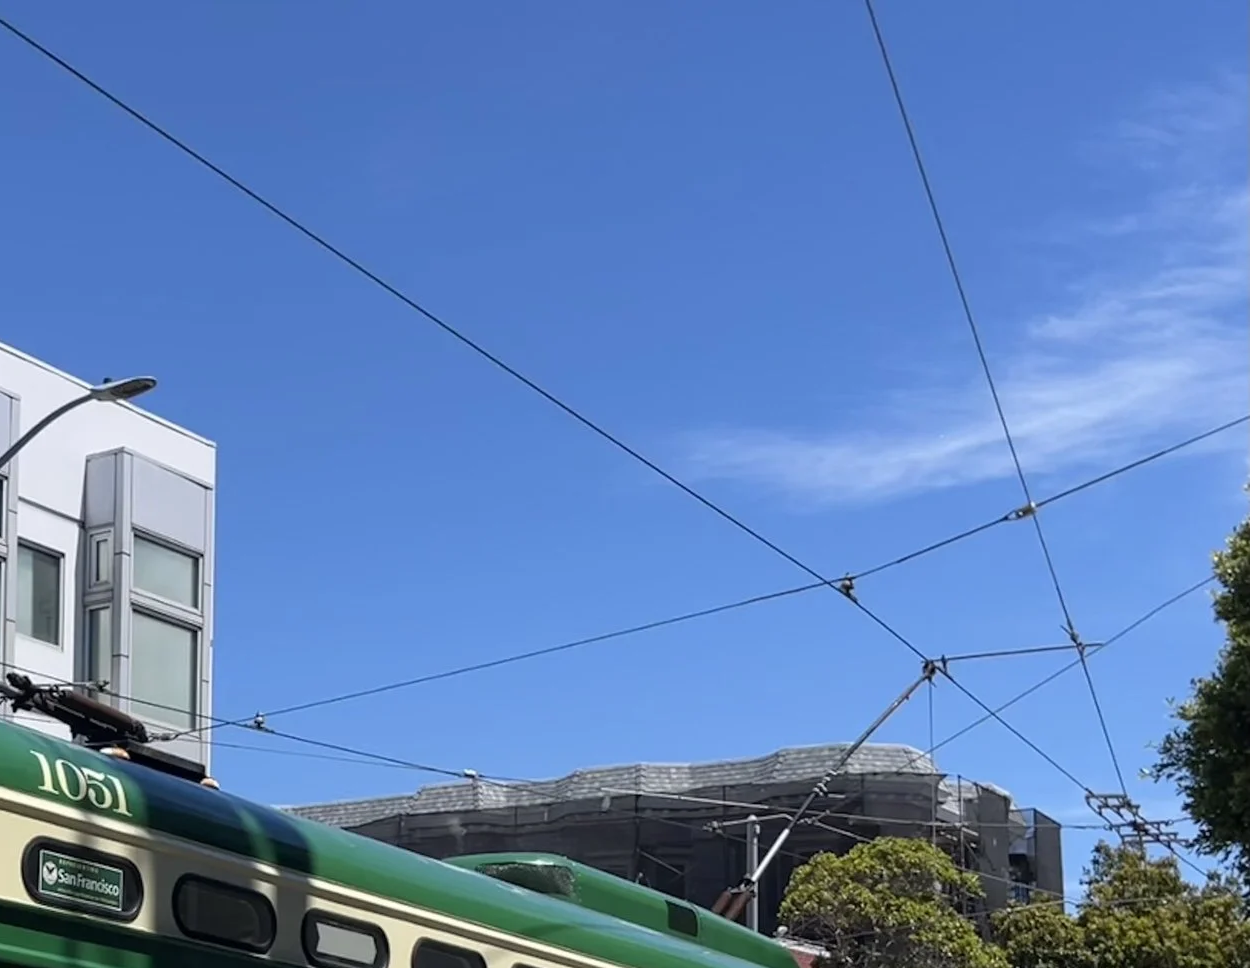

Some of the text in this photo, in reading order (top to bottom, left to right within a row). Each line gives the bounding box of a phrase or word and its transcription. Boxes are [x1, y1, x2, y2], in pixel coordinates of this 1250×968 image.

[30, 750, 133, 817] 1051
[57, 868, 79, 888] San
[76, 873, 120, 897] Francisco
